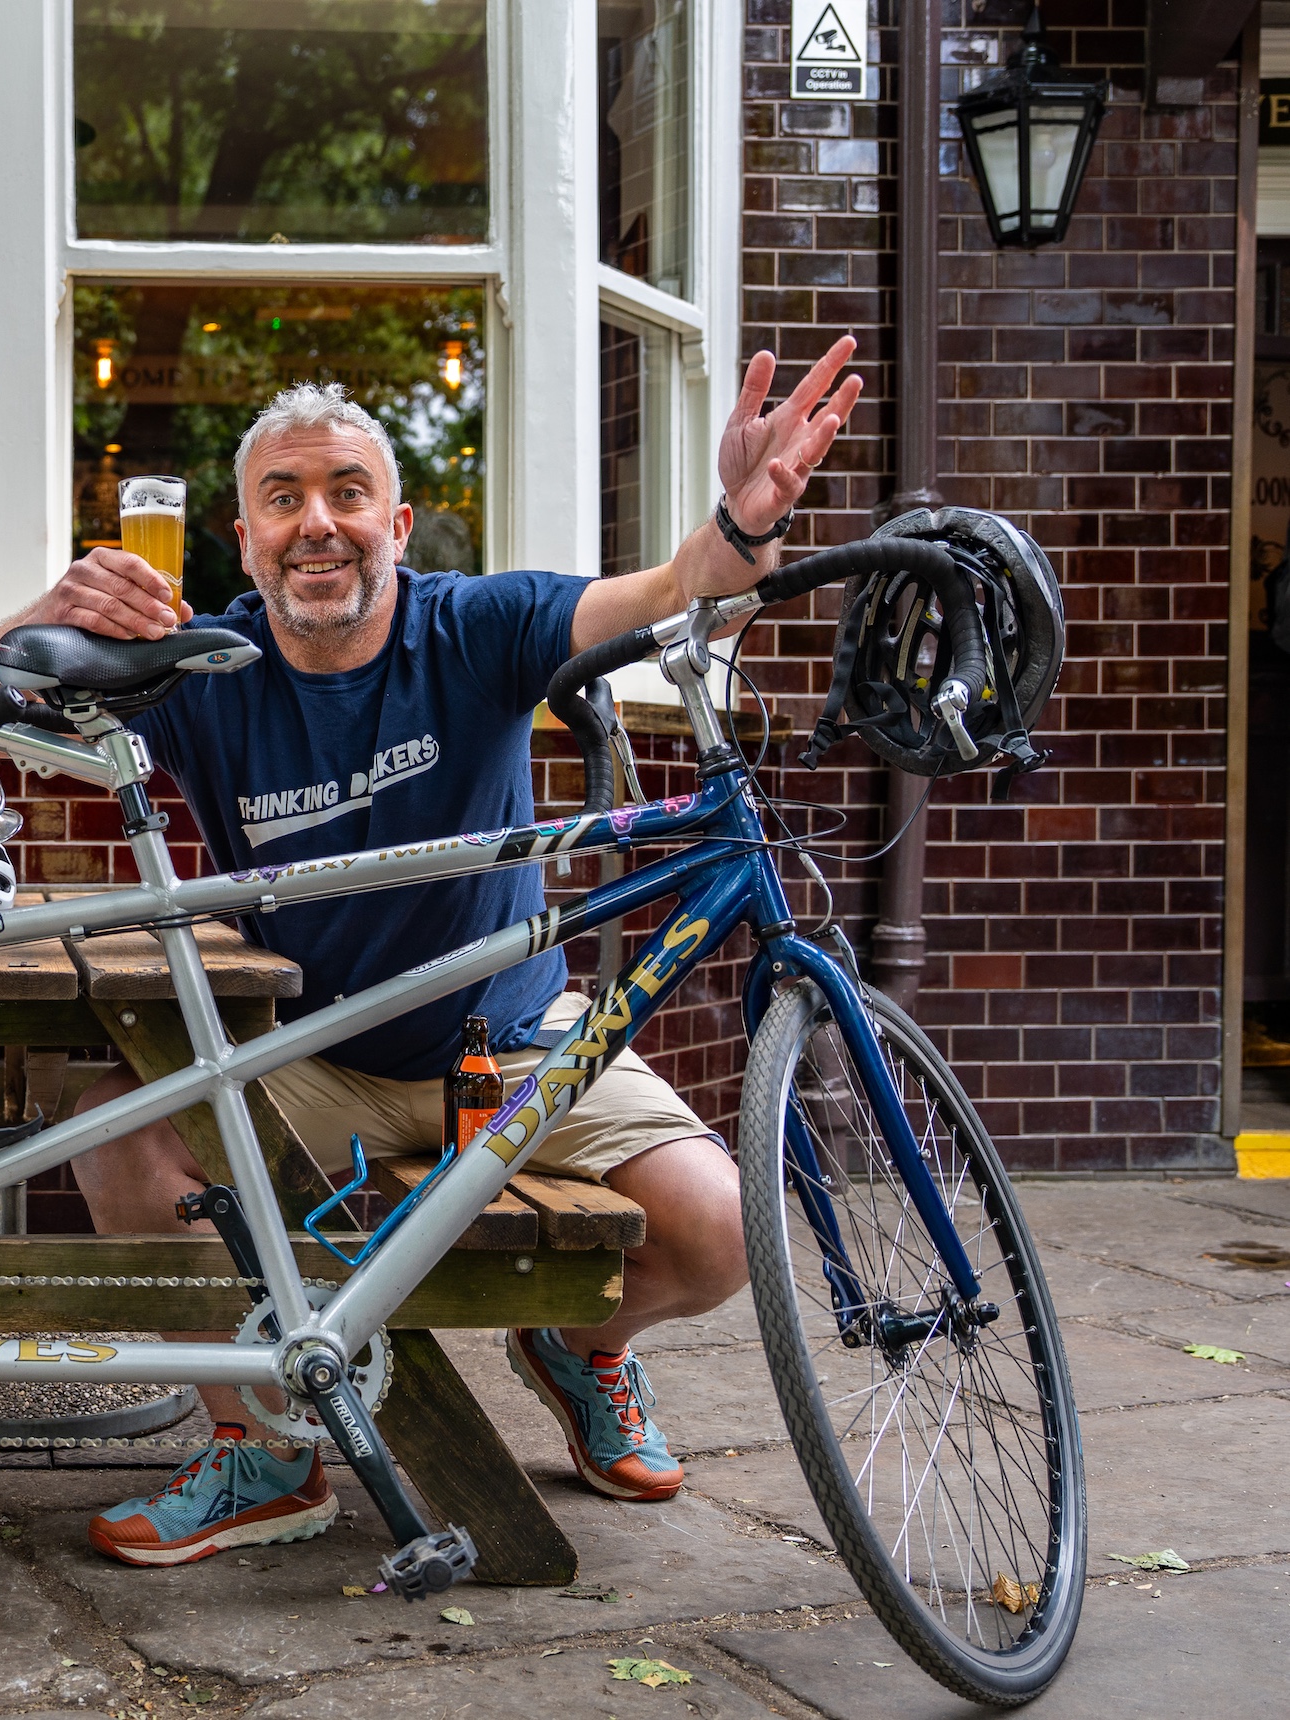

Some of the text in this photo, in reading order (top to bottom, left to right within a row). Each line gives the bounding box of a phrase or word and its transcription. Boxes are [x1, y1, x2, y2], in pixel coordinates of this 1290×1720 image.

[805, 79, 852, 91] Operation
[810, 68, 848, 78] CCTV in
[238, 780, 339, 821] THINKING
[373, 837, 459, 861] Twin
[481, 912, 711, 1169] DAWES
[330, 1396, 373, 1458] TRUVATIV
